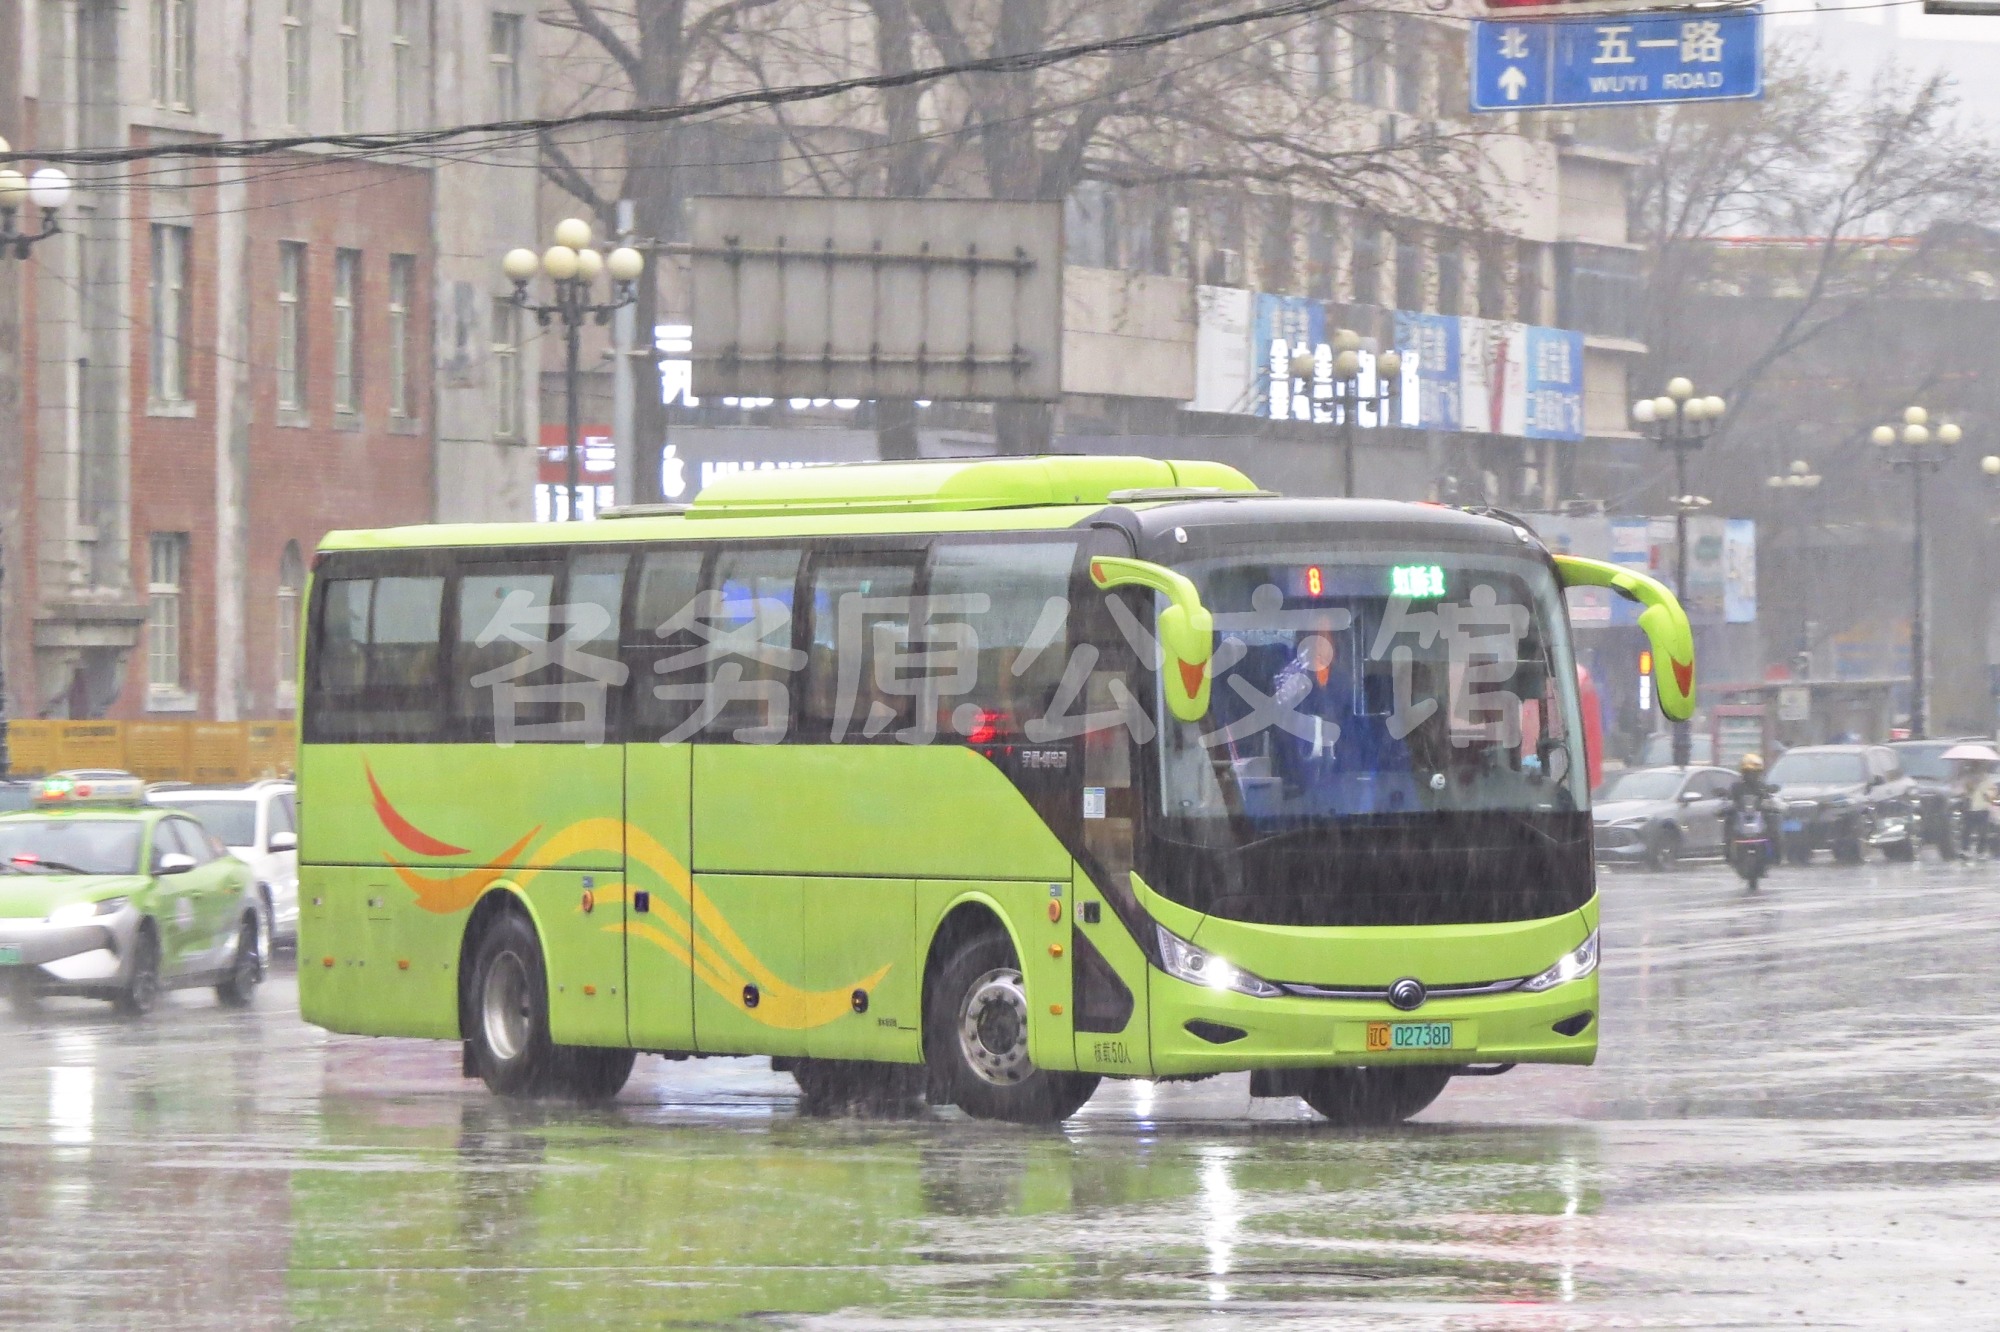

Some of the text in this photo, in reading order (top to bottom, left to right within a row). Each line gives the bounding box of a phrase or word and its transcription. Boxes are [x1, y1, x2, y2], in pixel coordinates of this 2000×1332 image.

[1498, 26, 1530, 59] 北
[1591, 21, 1725, 64] 五一路
[1589, 71, 1724, 93] WUYI ROAD
[1307, 566, 1322, 596] 8
